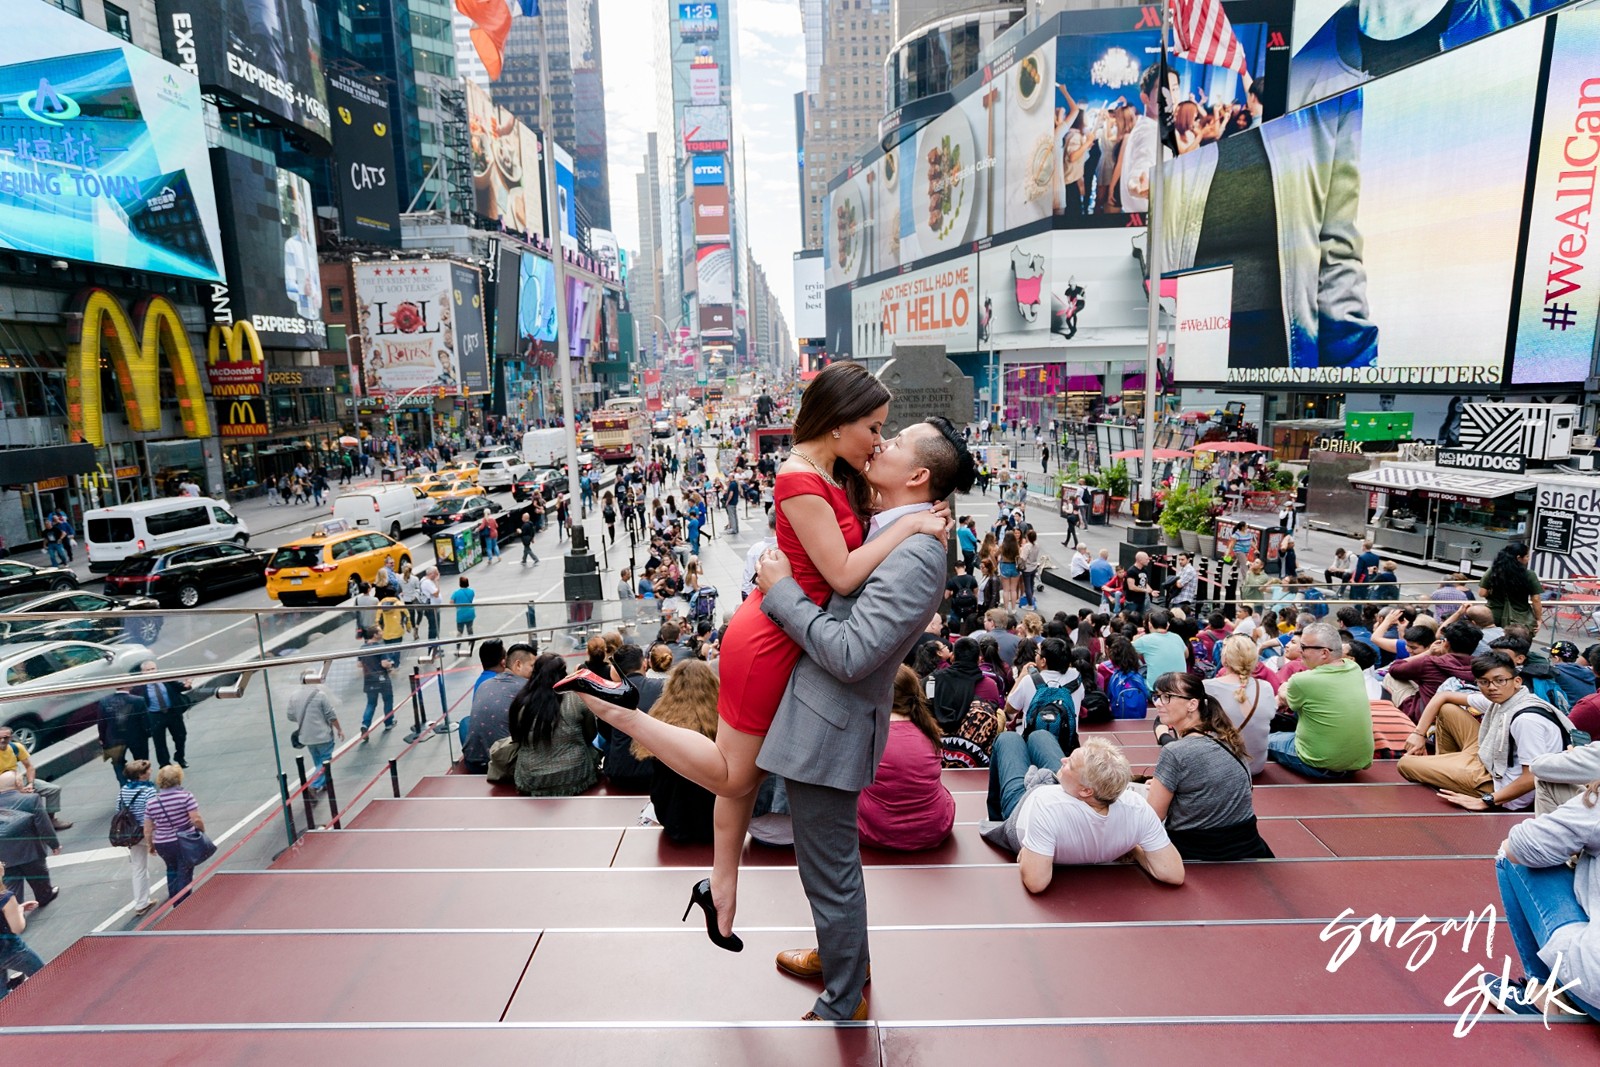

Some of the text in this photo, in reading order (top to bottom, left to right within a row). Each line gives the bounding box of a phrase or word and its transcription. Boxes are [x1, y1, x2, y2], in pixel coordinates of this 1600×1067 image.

[685, 5, 713, 19] 1:25
[226, 50, 295, 104] EXPRESS
[367, 88, 380, 98] AND
[686, 141, 728, 150] TOSHIBA
[351, 161, 386, 190] CATS
[702, 165, 722, 174] TDK
[69, 173, 142, 200] TOWN
[1542, 77, 1600, 331] #WeAllCan
[361, 278, 376, 286] THE
[880, 267, 969, 302] AND THEY STILL HAD ME
[808, 292, 821, 300] sell
[252, 315, 306, 334] EXPRESS
[883, 302, 900, 335] AT
[463, 333, 479, 356] CATS
[209, 366, 262, 376] McDonald's
[1228, 365, 1500, 384] AMERICAN EAGLE OUTFITTERS
[344, 397, 376, 407] GFTS
[1320, 438, 1364, 454] DRINK
[1456, 453, 1482, 468] HOT
[1482, 455, 1521, 471] DOGS
[1441, 493, 1457, 501] DOGS
[1540, 489, 1600, 512] snack
[1572, 513, 1600, 553] BOX
